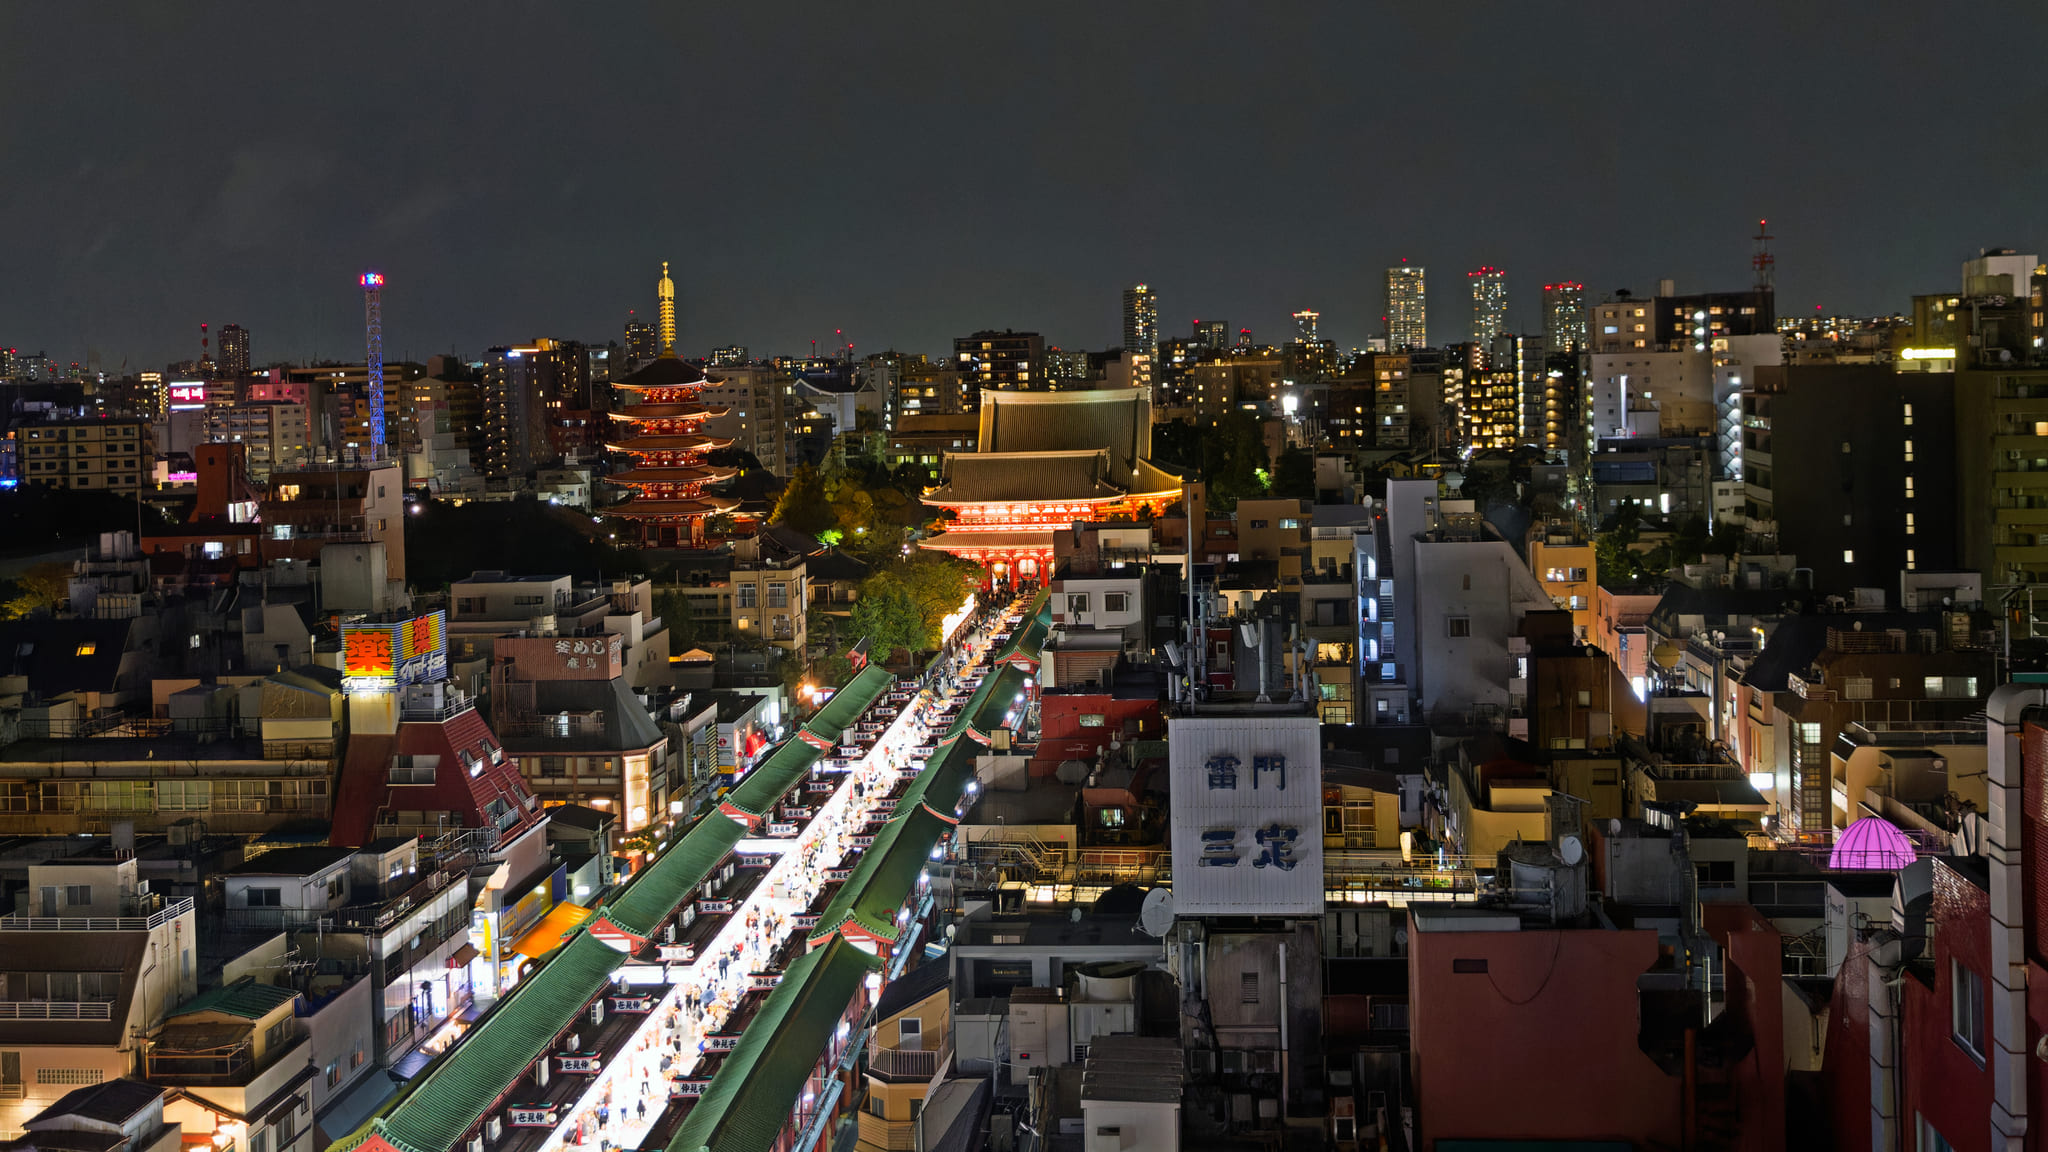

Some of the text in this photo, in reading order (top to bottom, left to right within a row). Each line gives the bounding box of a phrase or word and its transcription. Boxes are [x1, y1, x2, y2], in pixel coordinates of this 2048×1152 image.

[345, 631, 391, 671] 薬
[413, 614, 432, 654] 薬
[555, 639, 605, 655] 釜めし
[1204, 755, 1286, 791] 雷門
[1199, 824, 1298, 871] 三定
